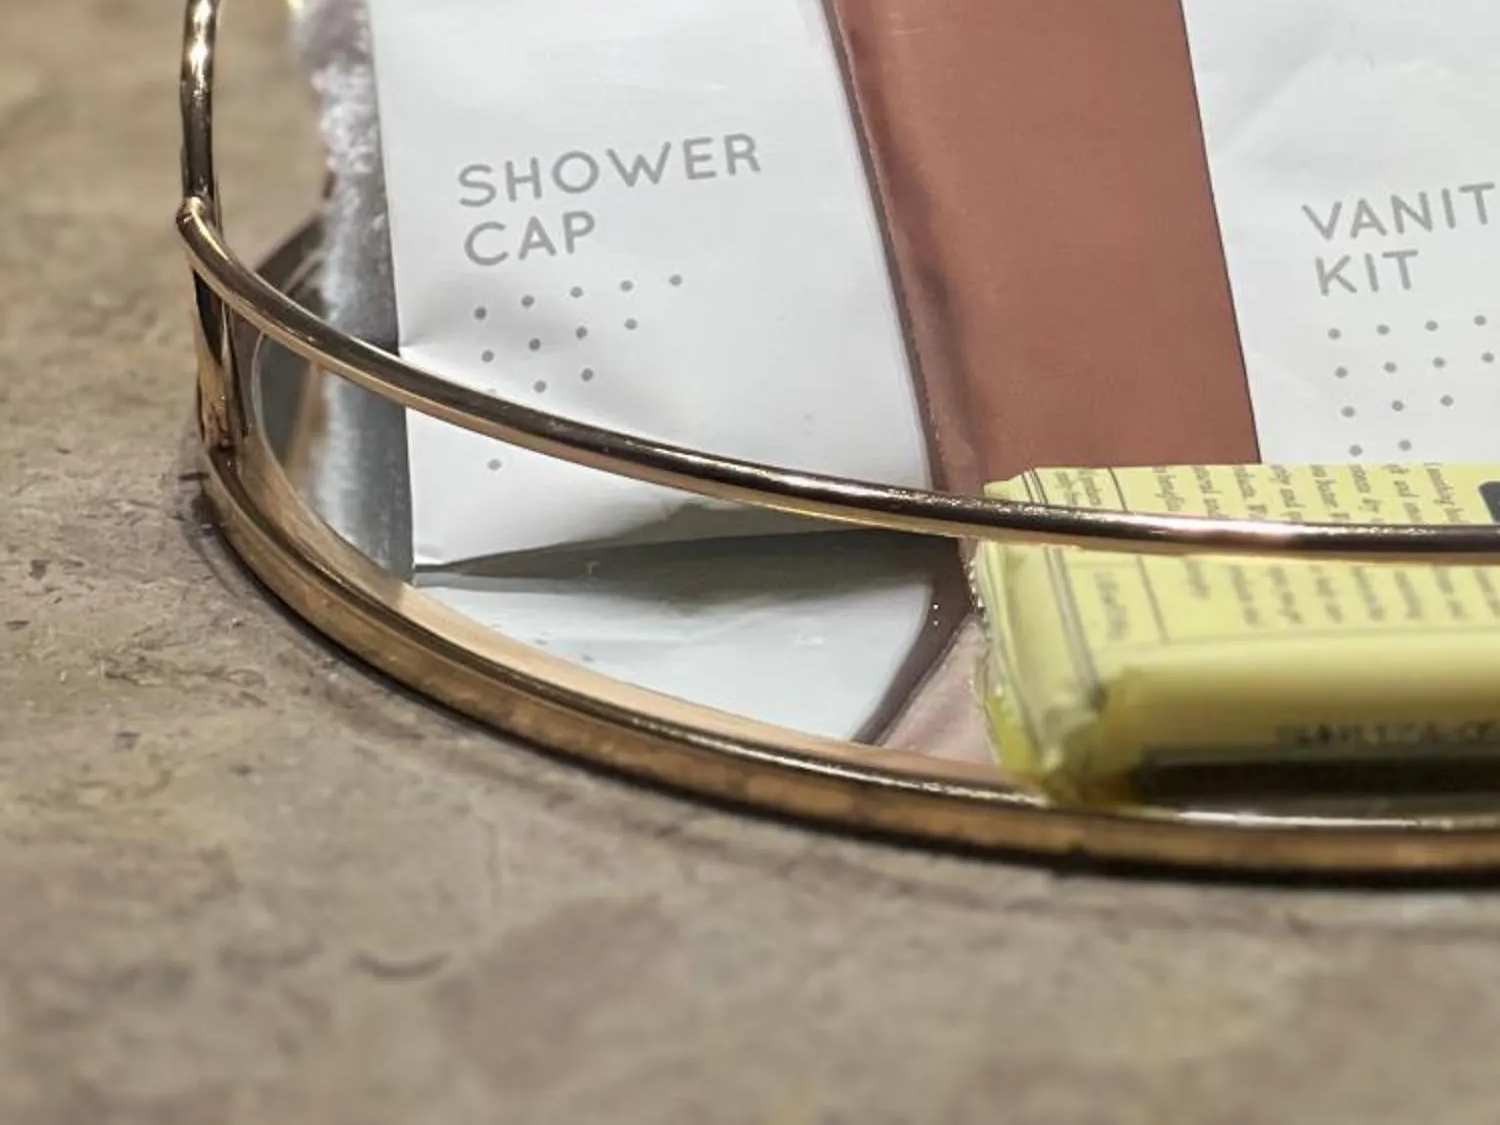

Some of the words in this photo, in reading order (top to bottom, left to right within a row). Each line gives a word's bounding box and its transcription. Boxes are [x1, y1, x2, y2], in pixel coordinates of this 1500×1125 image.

[458, 132, 761, 208] SHOWER
[463, 210, 596, 267] CAP
[1314, 248, 1419, 297] KIT
